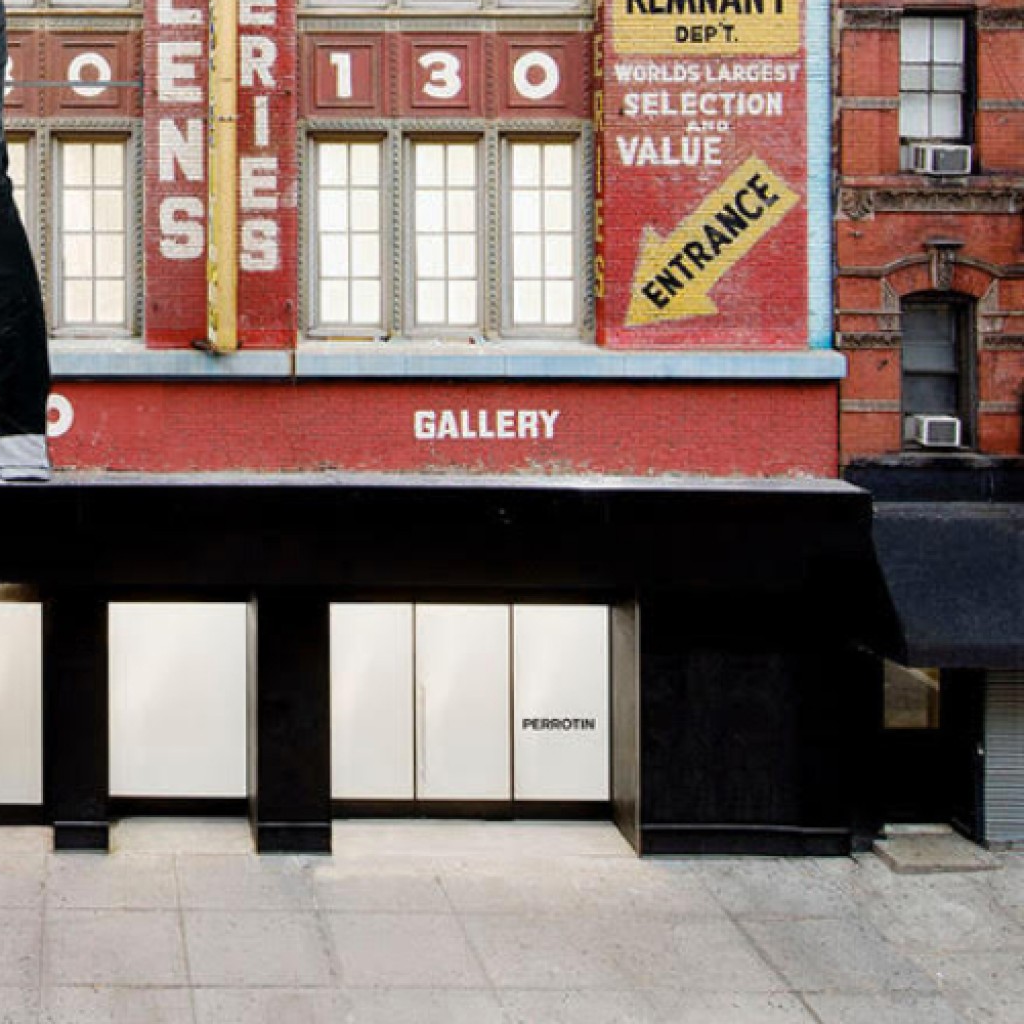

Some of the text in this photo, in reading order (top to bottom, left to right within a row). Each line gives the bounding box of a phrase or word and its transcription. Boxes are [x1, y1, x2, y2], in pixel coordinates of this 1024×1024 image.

[614, 62, 800, 83] WORLDS LARGEST
[624, 90, 783, 116] SELECTION
[616, 137, 722, 165] VALUE
[641, 172, 780, 309] ENTRANCE
[414, 409, 560, 438] GALLERY
[522, 718, 595, 730] PERROTIN
